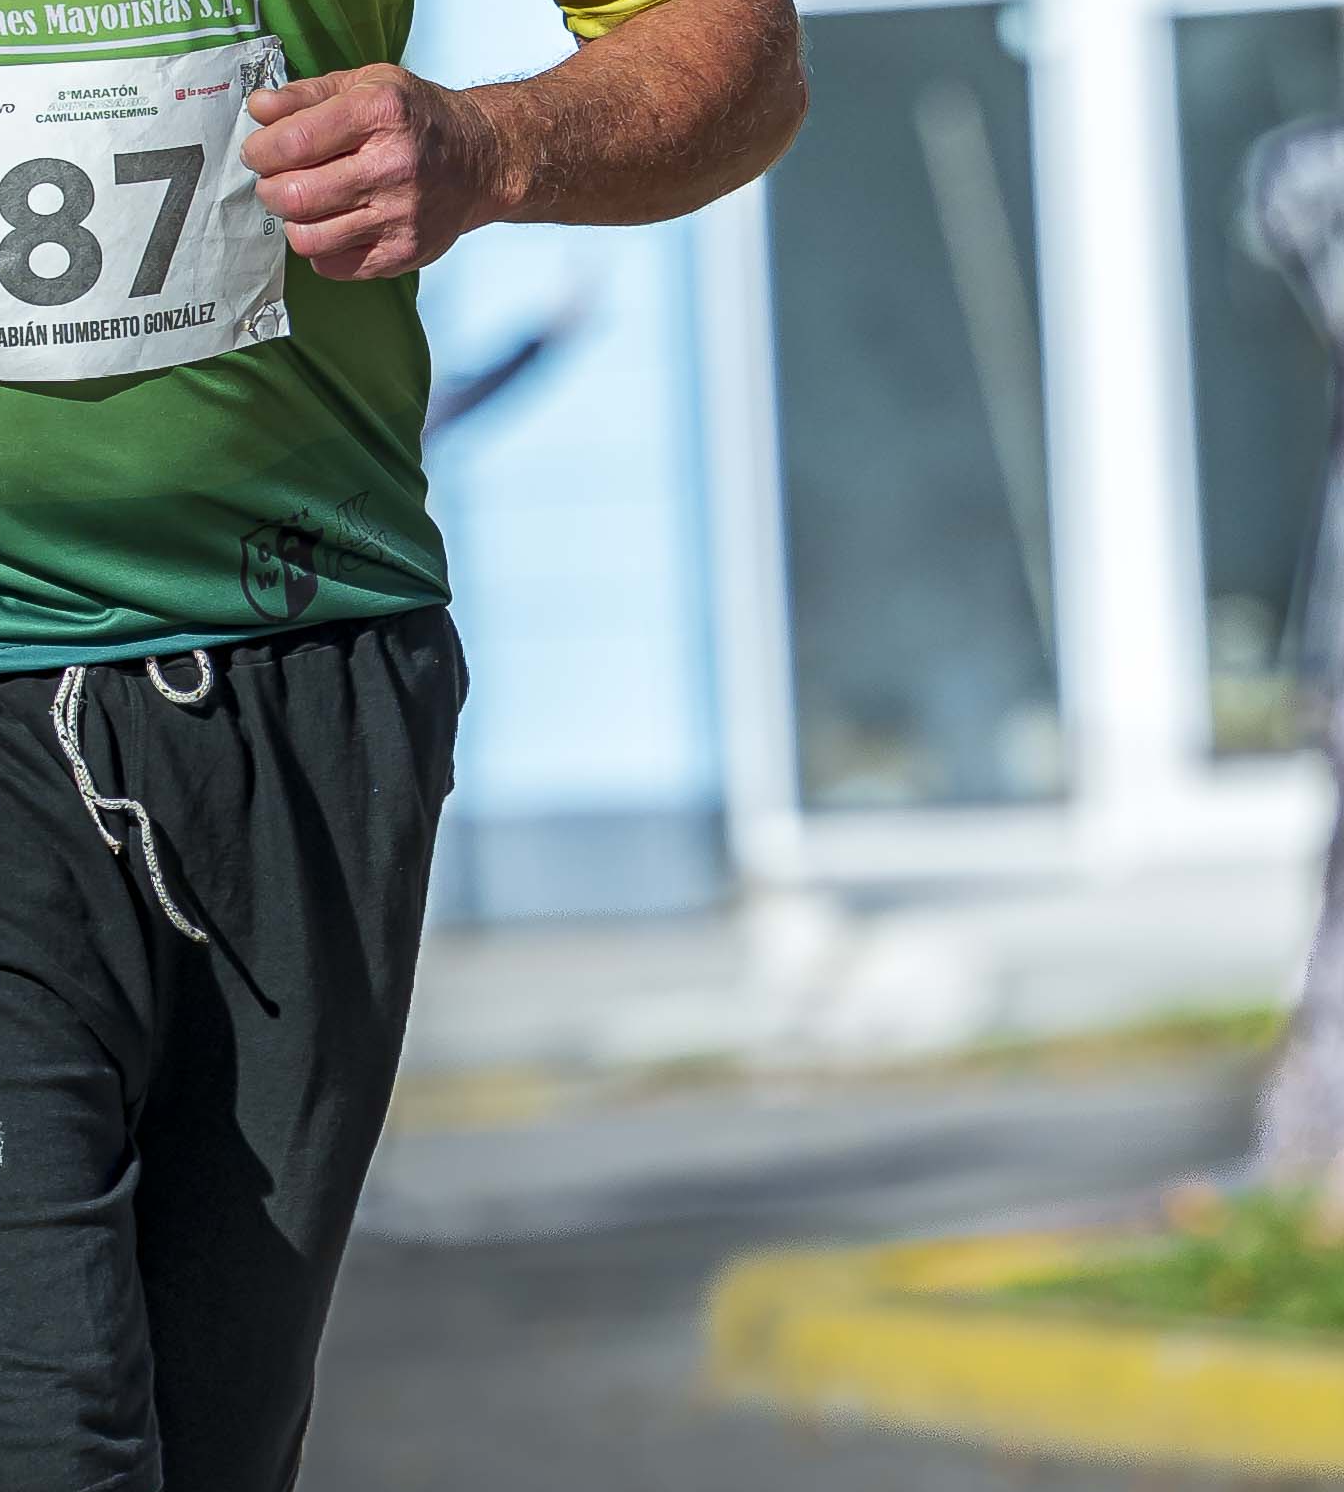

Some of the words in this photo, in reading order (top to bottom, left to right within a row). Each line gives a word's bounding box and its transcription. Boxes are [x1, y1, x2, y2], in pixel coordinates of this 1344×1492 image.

[35, 106, 159, 123] CAWILLIAMSKEMMIS
[52, 315, 140, 345] HUMBERTO
[143, 302, 217, 335] GONZÁLEZ
